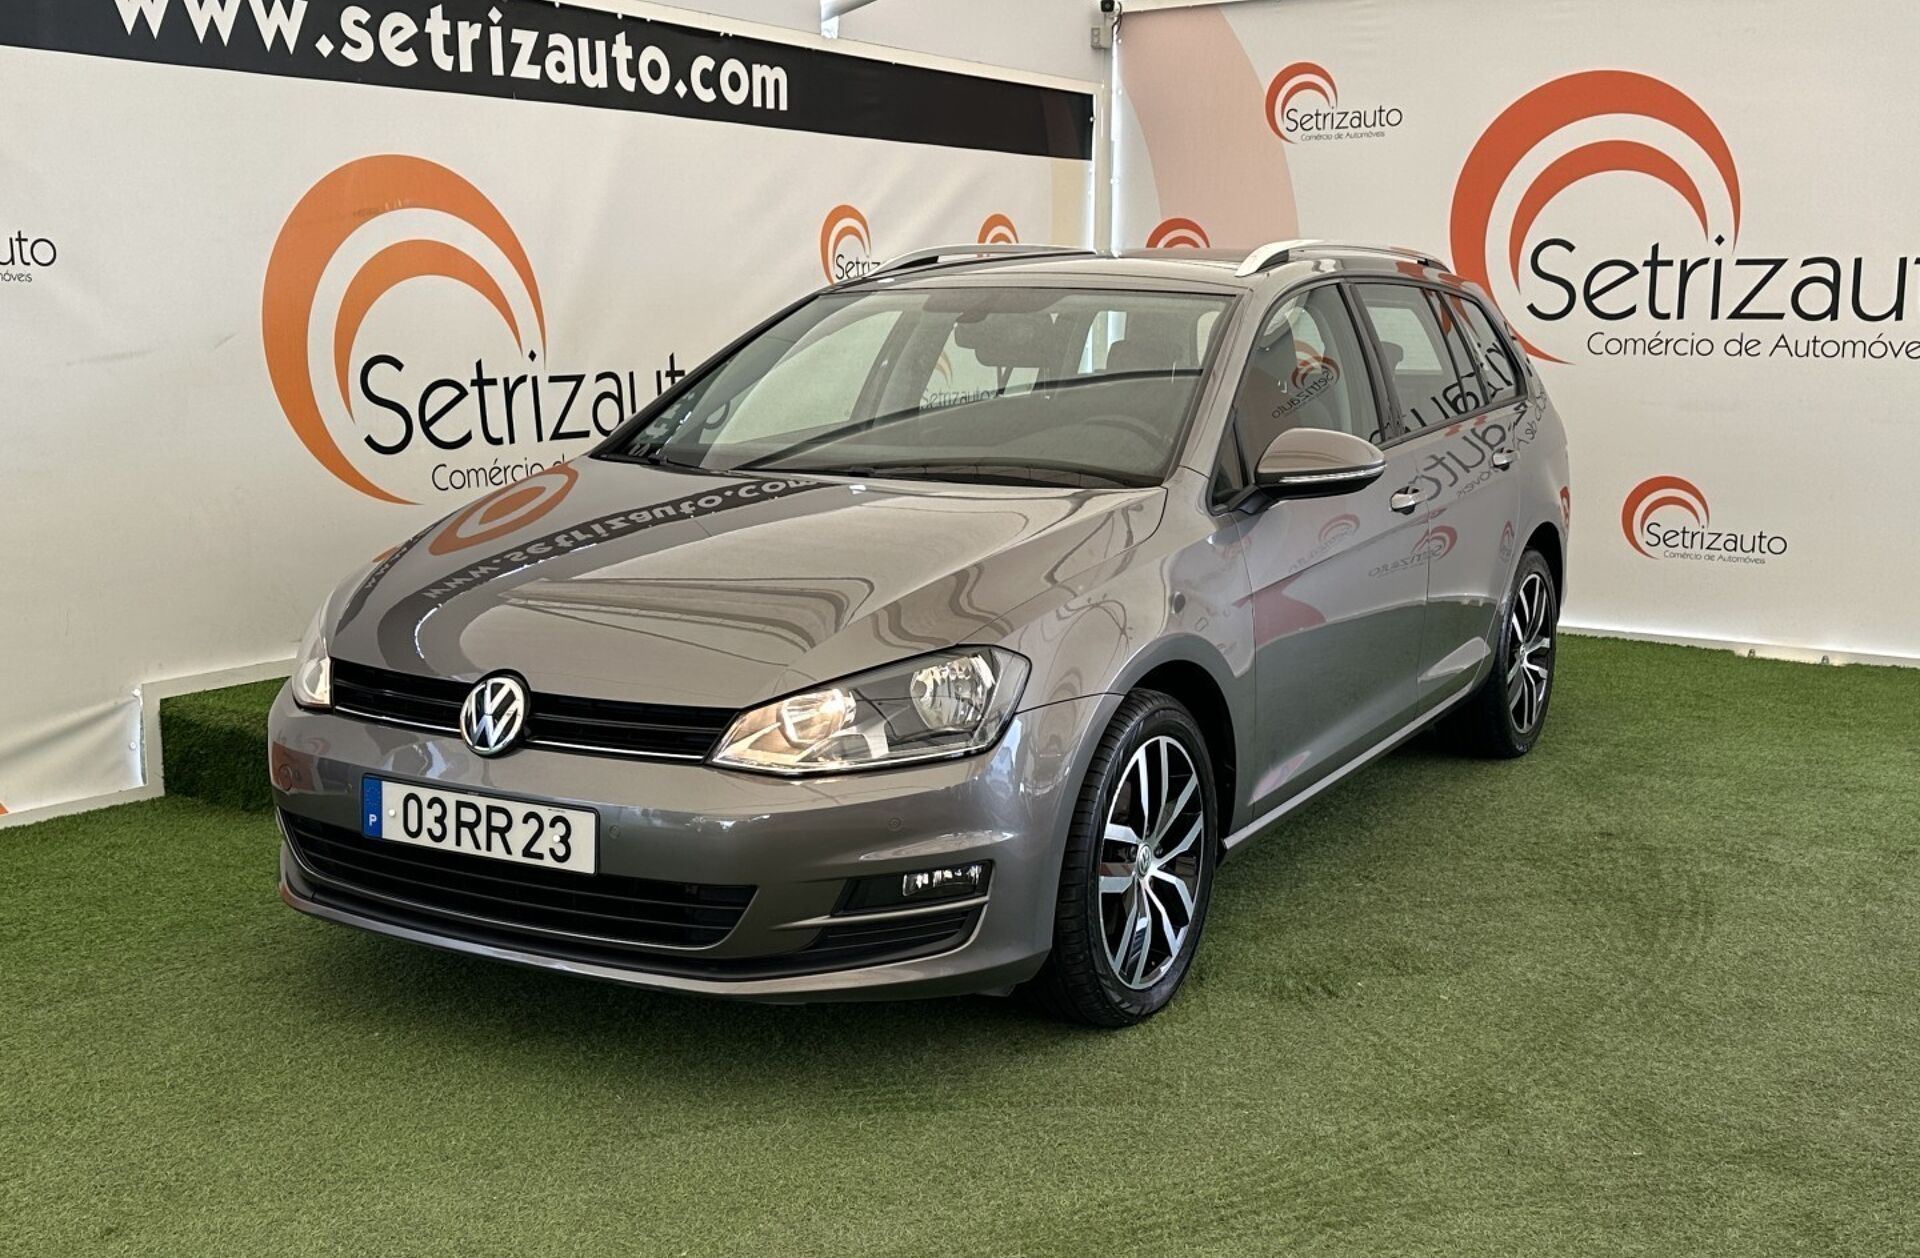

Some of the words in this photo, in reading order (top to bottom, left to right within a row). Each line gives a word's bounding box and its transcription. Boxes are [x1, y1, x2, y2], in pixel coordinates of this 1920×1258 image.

[114, 0, 788, 111] www.setrizauto.com
[1285, 105, 1403, 132] Setrizauto
[1526, 234, 1920, 322] Setrizau
[1587, 330, 1714, 356] Comércio
[1723, 332, 1761, 356] de
[1645, 522, 1787, 555] Setrizauto
[369, 814, 377, 827] P
